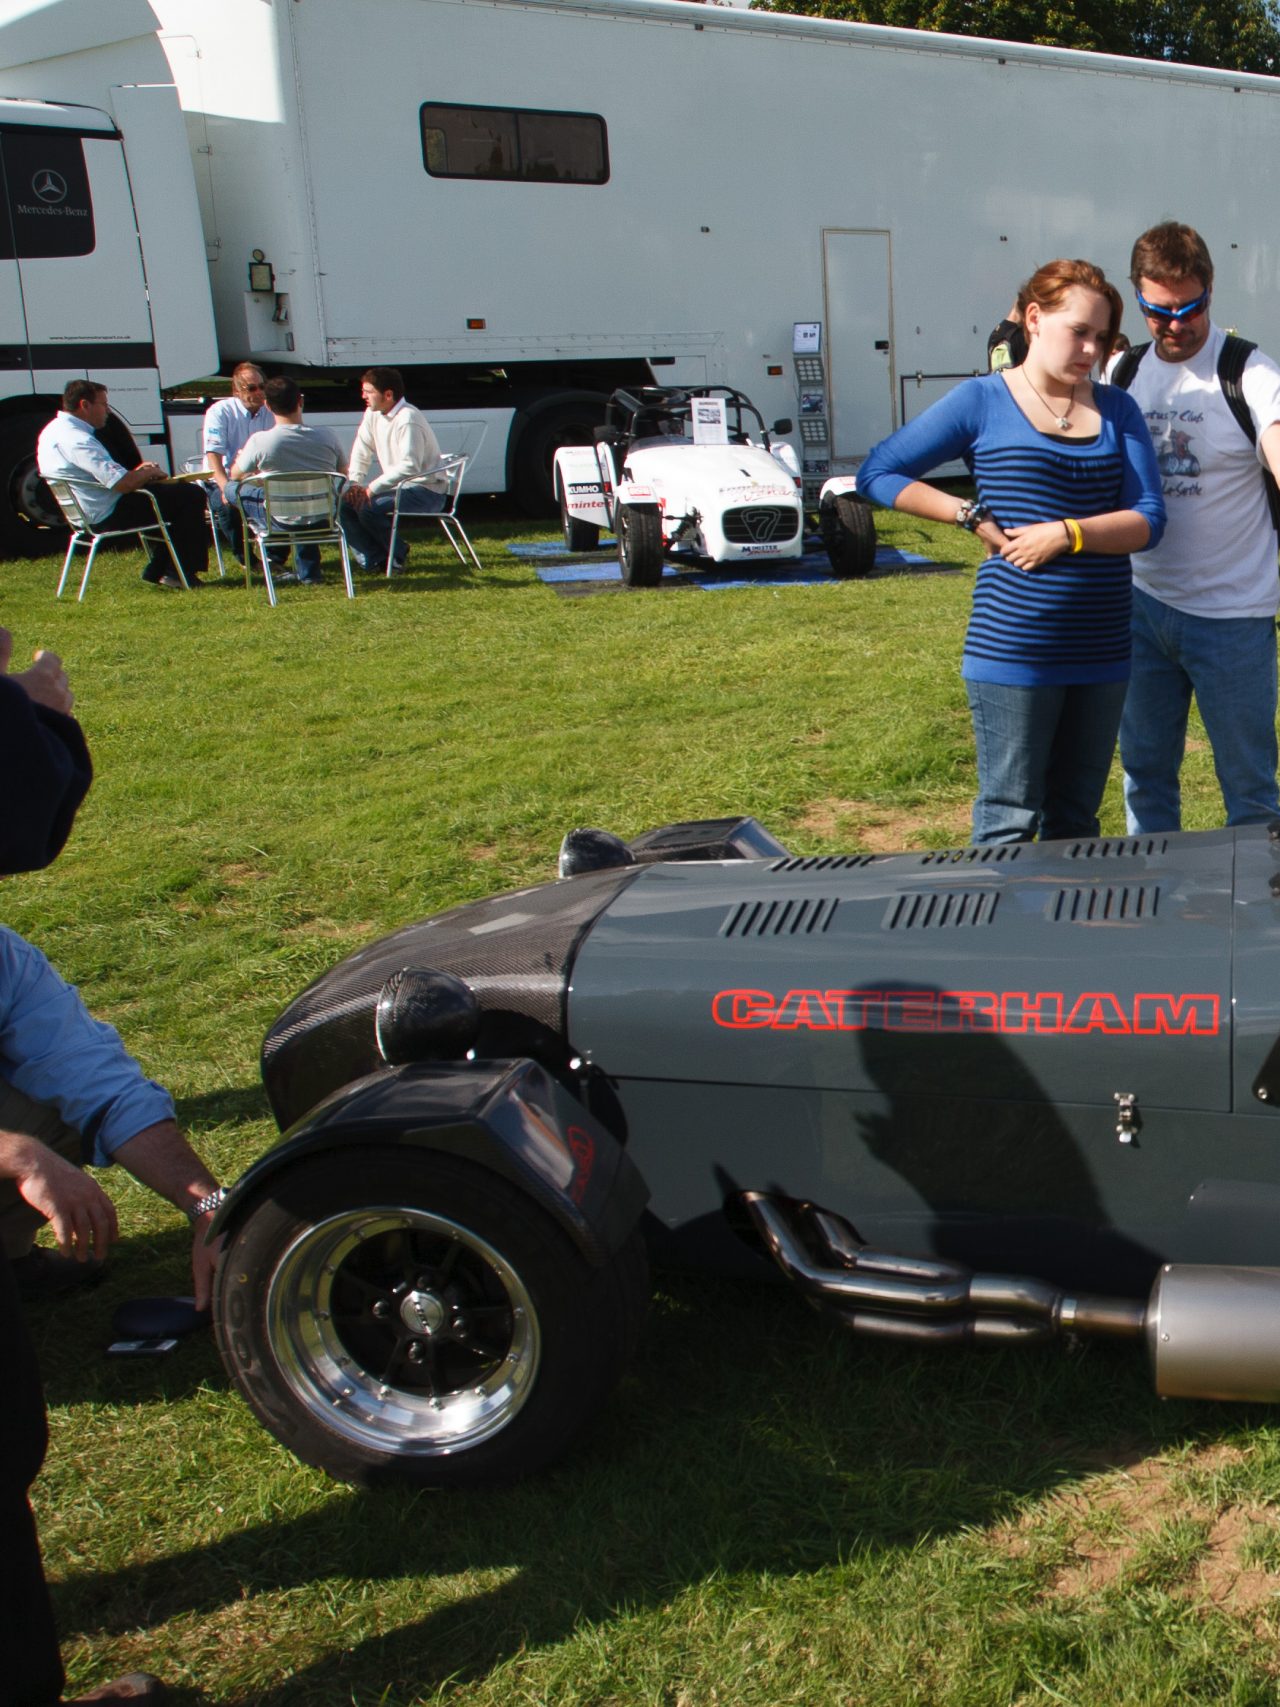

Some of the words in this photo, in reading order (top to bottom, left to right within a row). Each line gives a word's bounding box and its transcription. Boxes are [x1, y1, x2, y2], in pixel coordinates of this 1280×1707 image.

[17, 204, 89, 217] Mercedes-Benz
[1179, 409, 1204, 424] Club
[568, 485, 600, 495] KUMHO
[711, 988, 1220, 1035] CATERHAM
